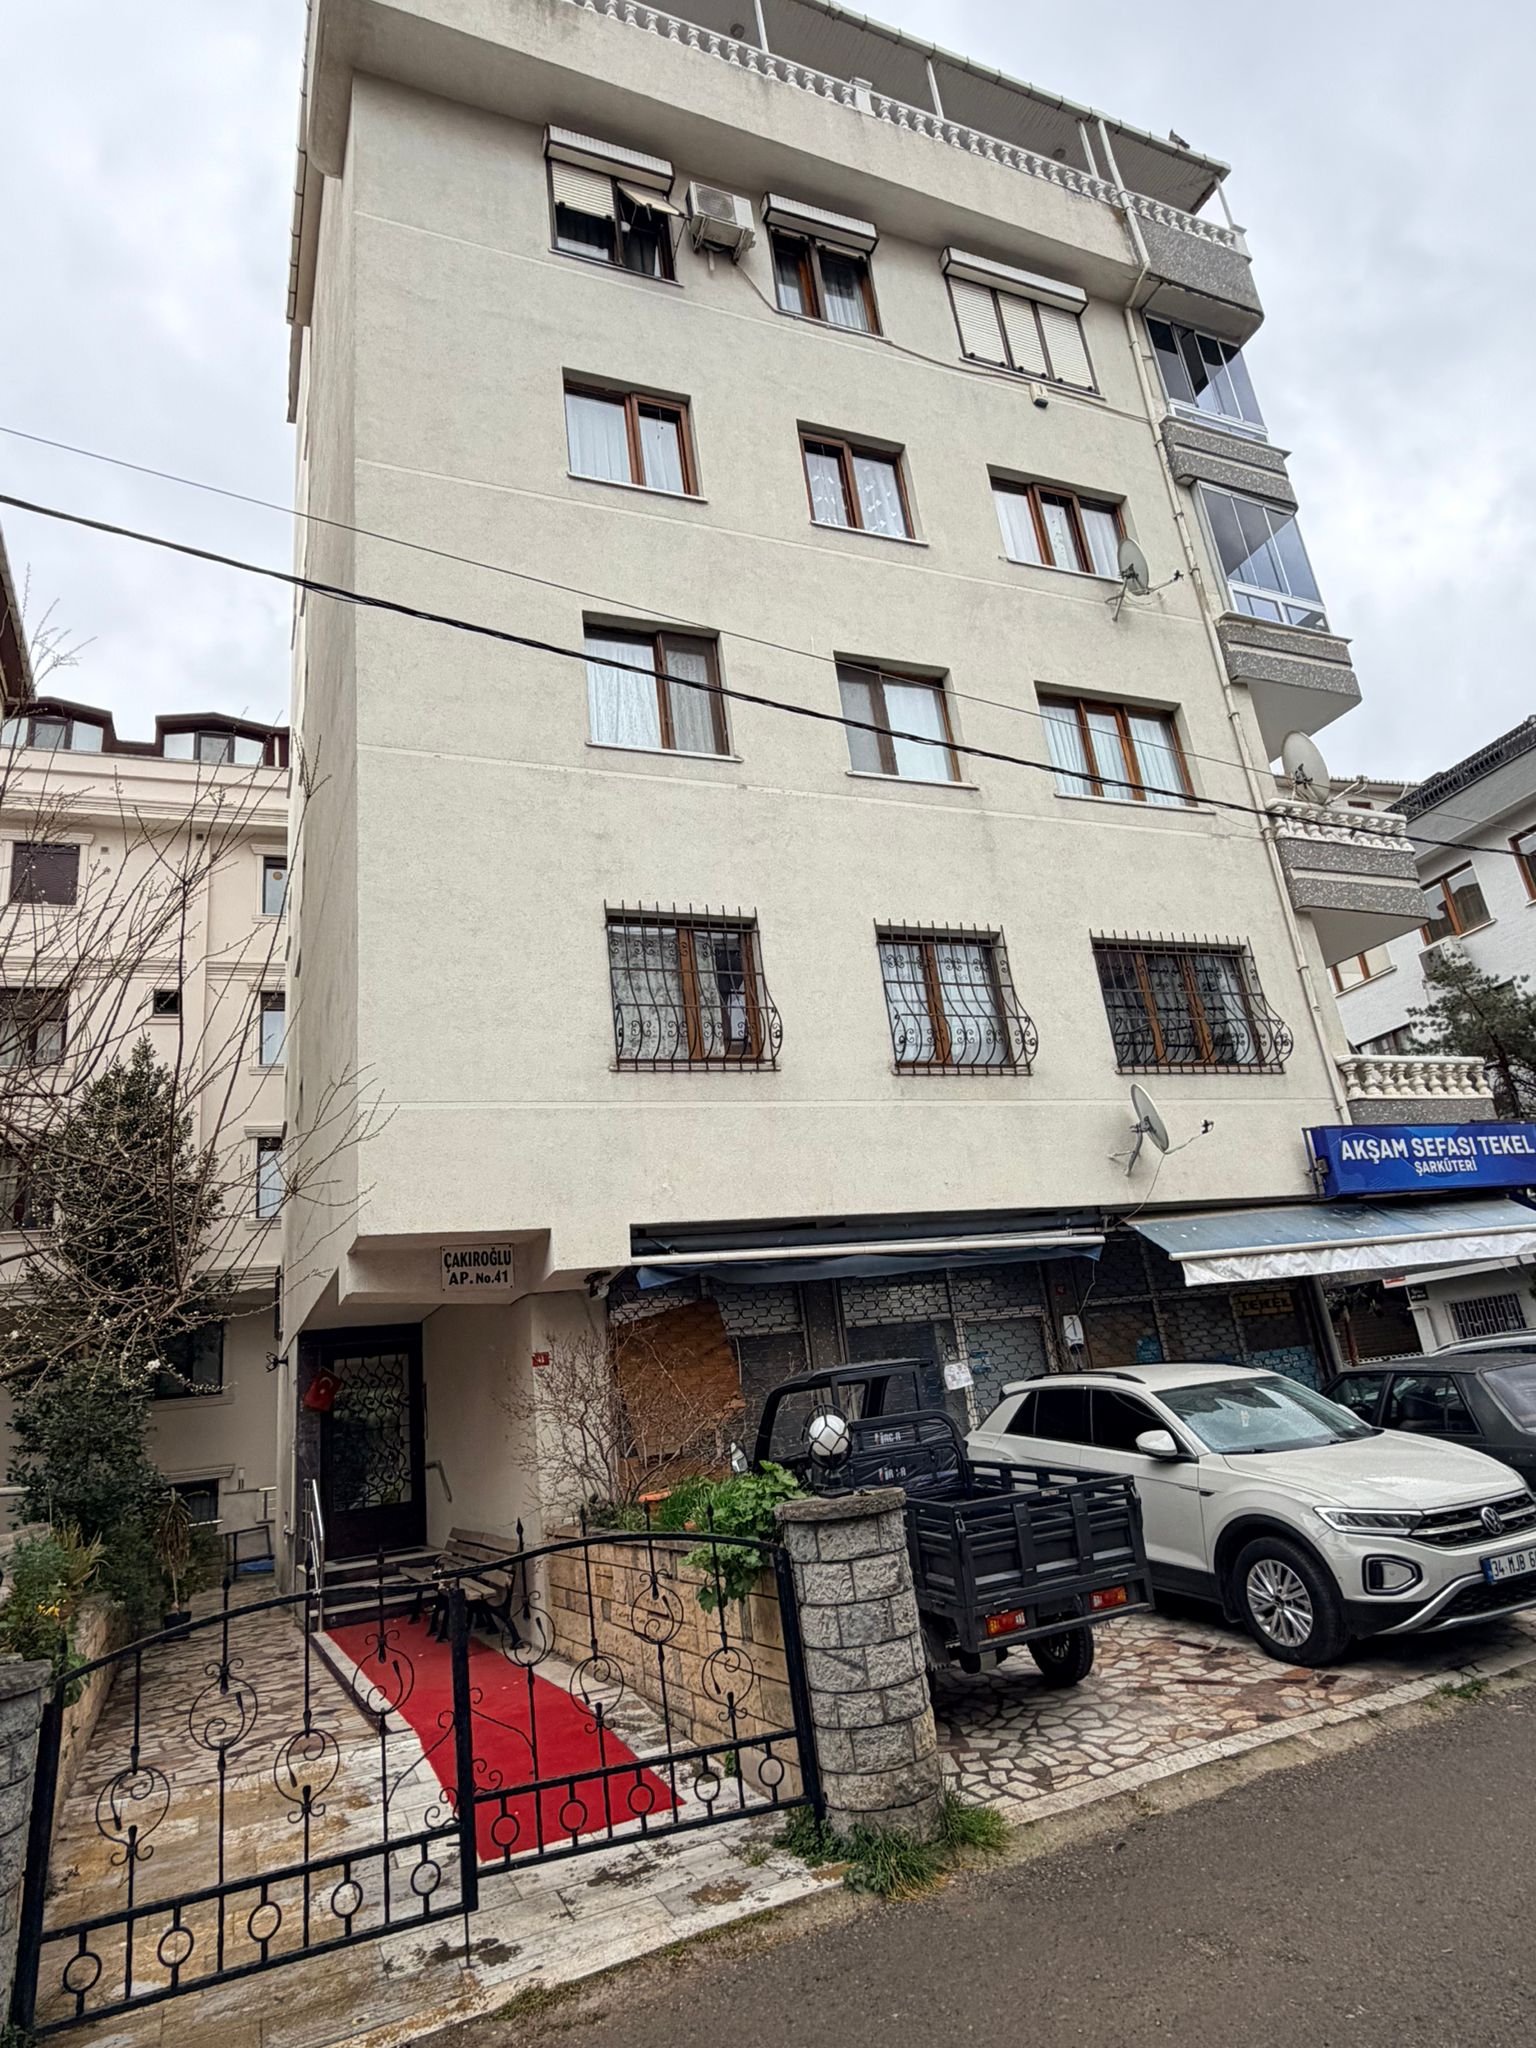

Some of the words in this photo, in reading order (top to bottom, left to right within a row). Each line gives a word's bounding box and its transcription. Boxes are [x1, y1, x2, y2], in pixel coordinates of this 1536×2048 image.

[1341, 1138, 1409, 1164] AKŞAM
[1413, 1136, 1478, 1158] SEFASI
[1477, 1135, 1536, 1156] TEKEL
[1414, 1158, 1478, 1176] ŞARKÜTERİ
[443, 1246, 512, 1273] ÇAKIROĞLU
[1491, 1559, 1505, 1578] 34
